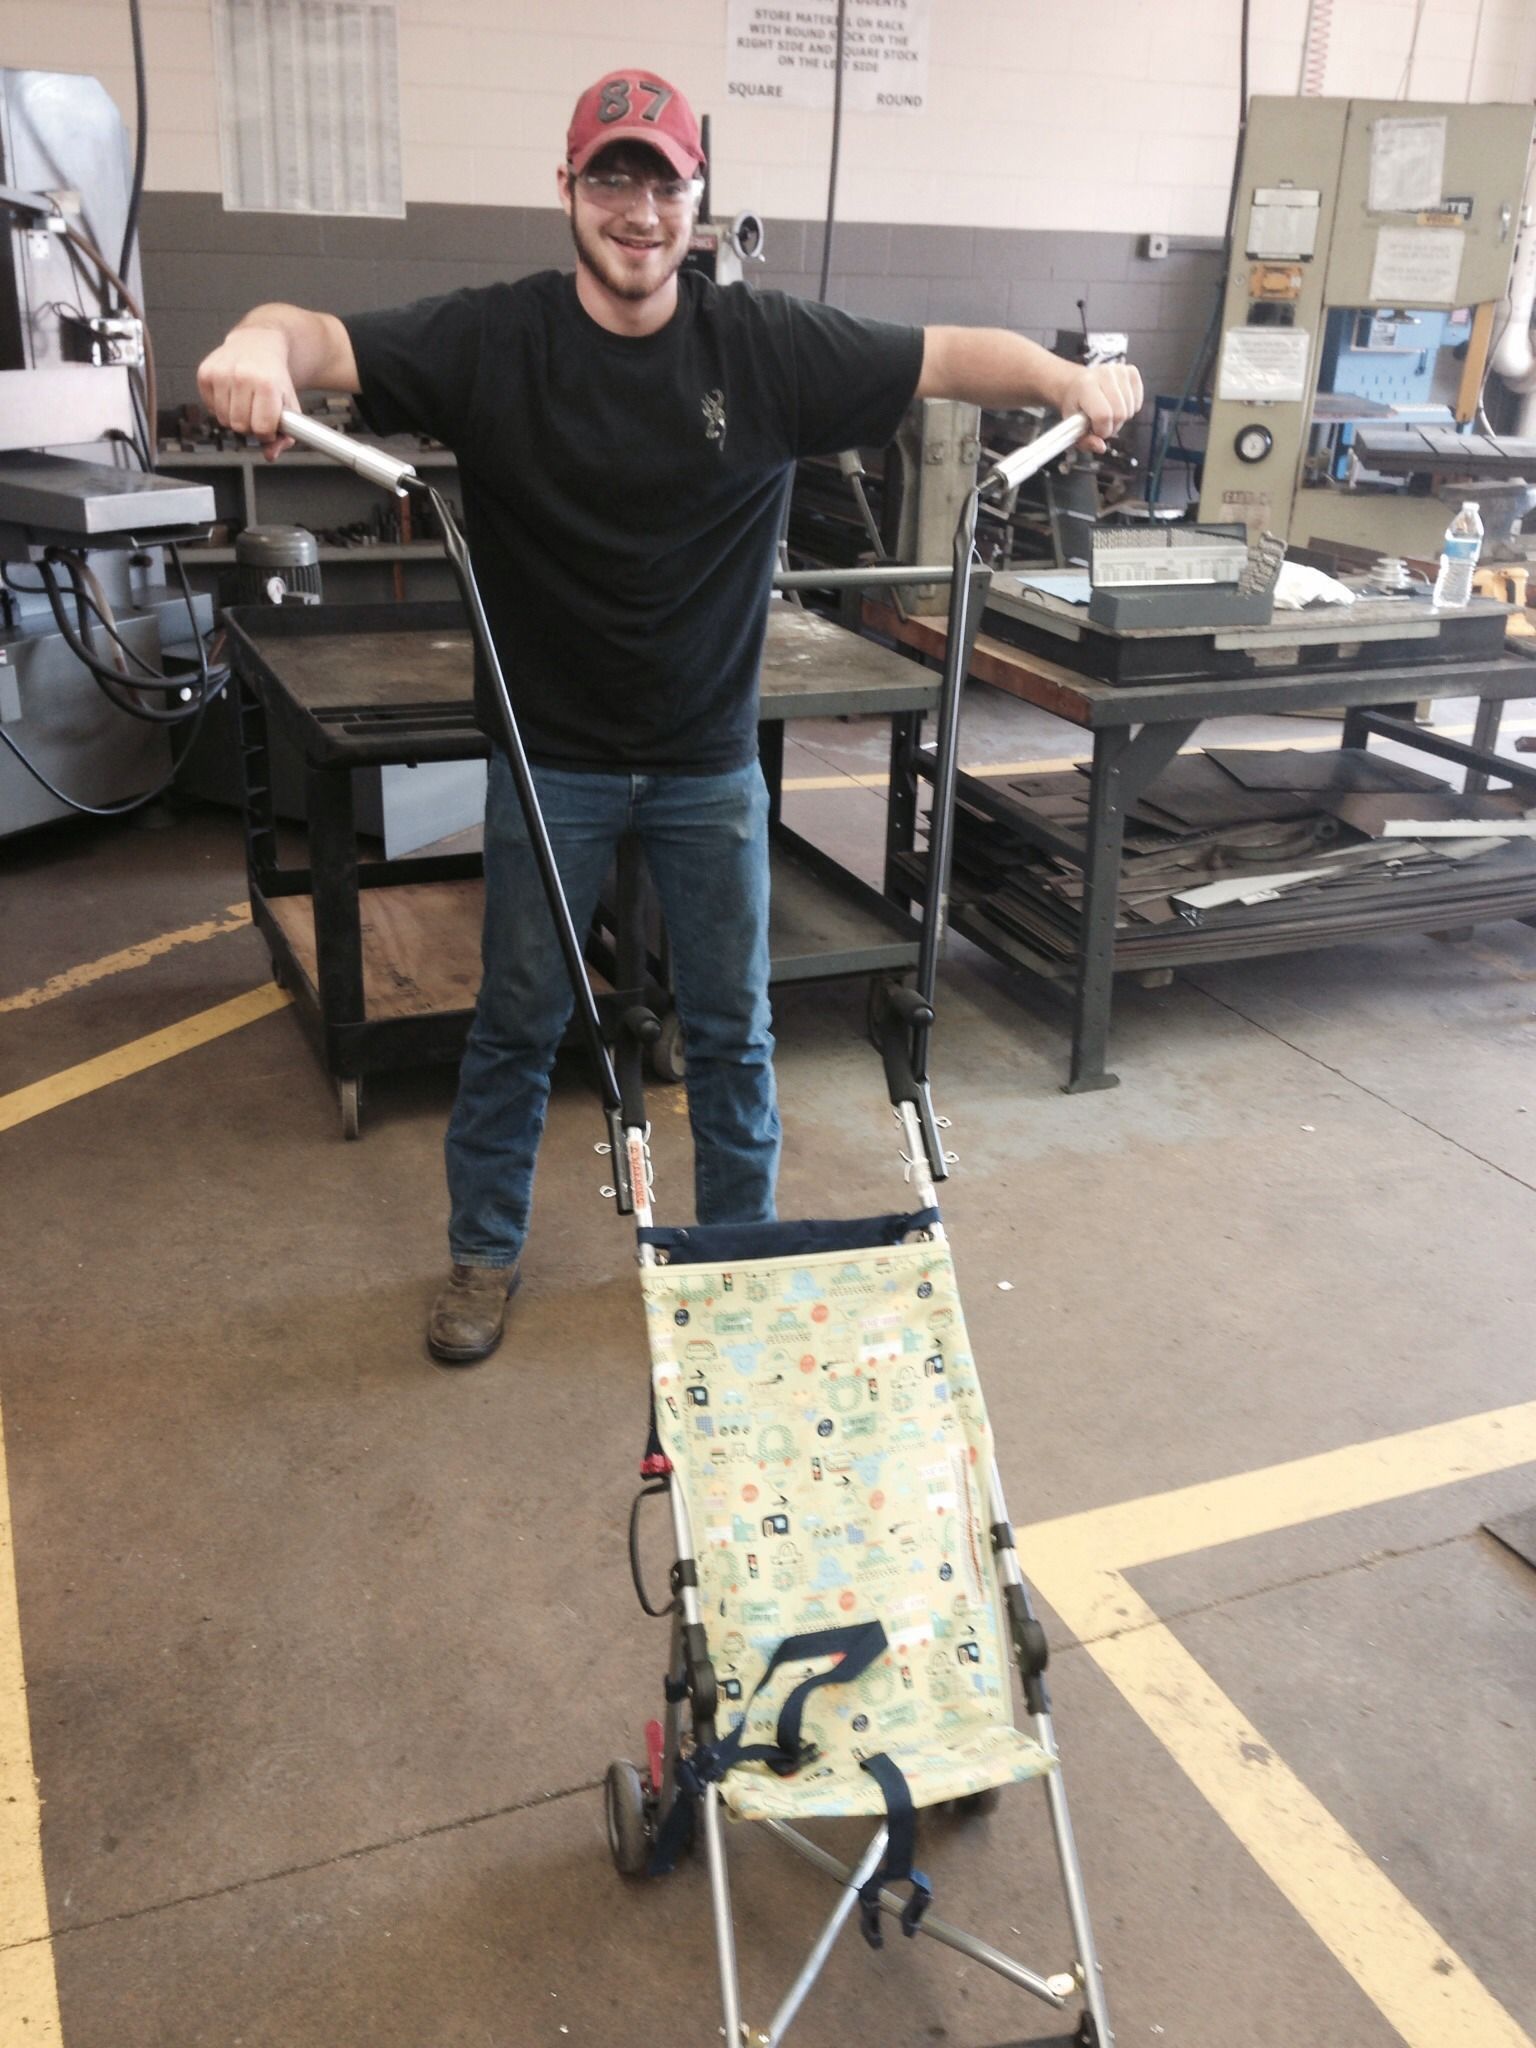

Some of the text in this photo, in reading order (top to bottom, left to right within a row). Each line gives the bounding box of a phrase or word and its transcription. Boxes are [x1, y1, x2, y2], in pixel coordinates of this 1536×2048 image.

[754, 9, 904, 31] STORE MATERL ON RACK
[749, 24, 908, 46] WITH ROUND SOCK ON THE
[737, 37, 918, 61] RIGHT SIDE AND QUARE STOCK
[778, 55, 879, 73] ON THE LET SIDE
[727, 82, 783, 98] SQUARE
[876, 92, 922, 107] ROUND
[597, 79, 672, 124] 87
